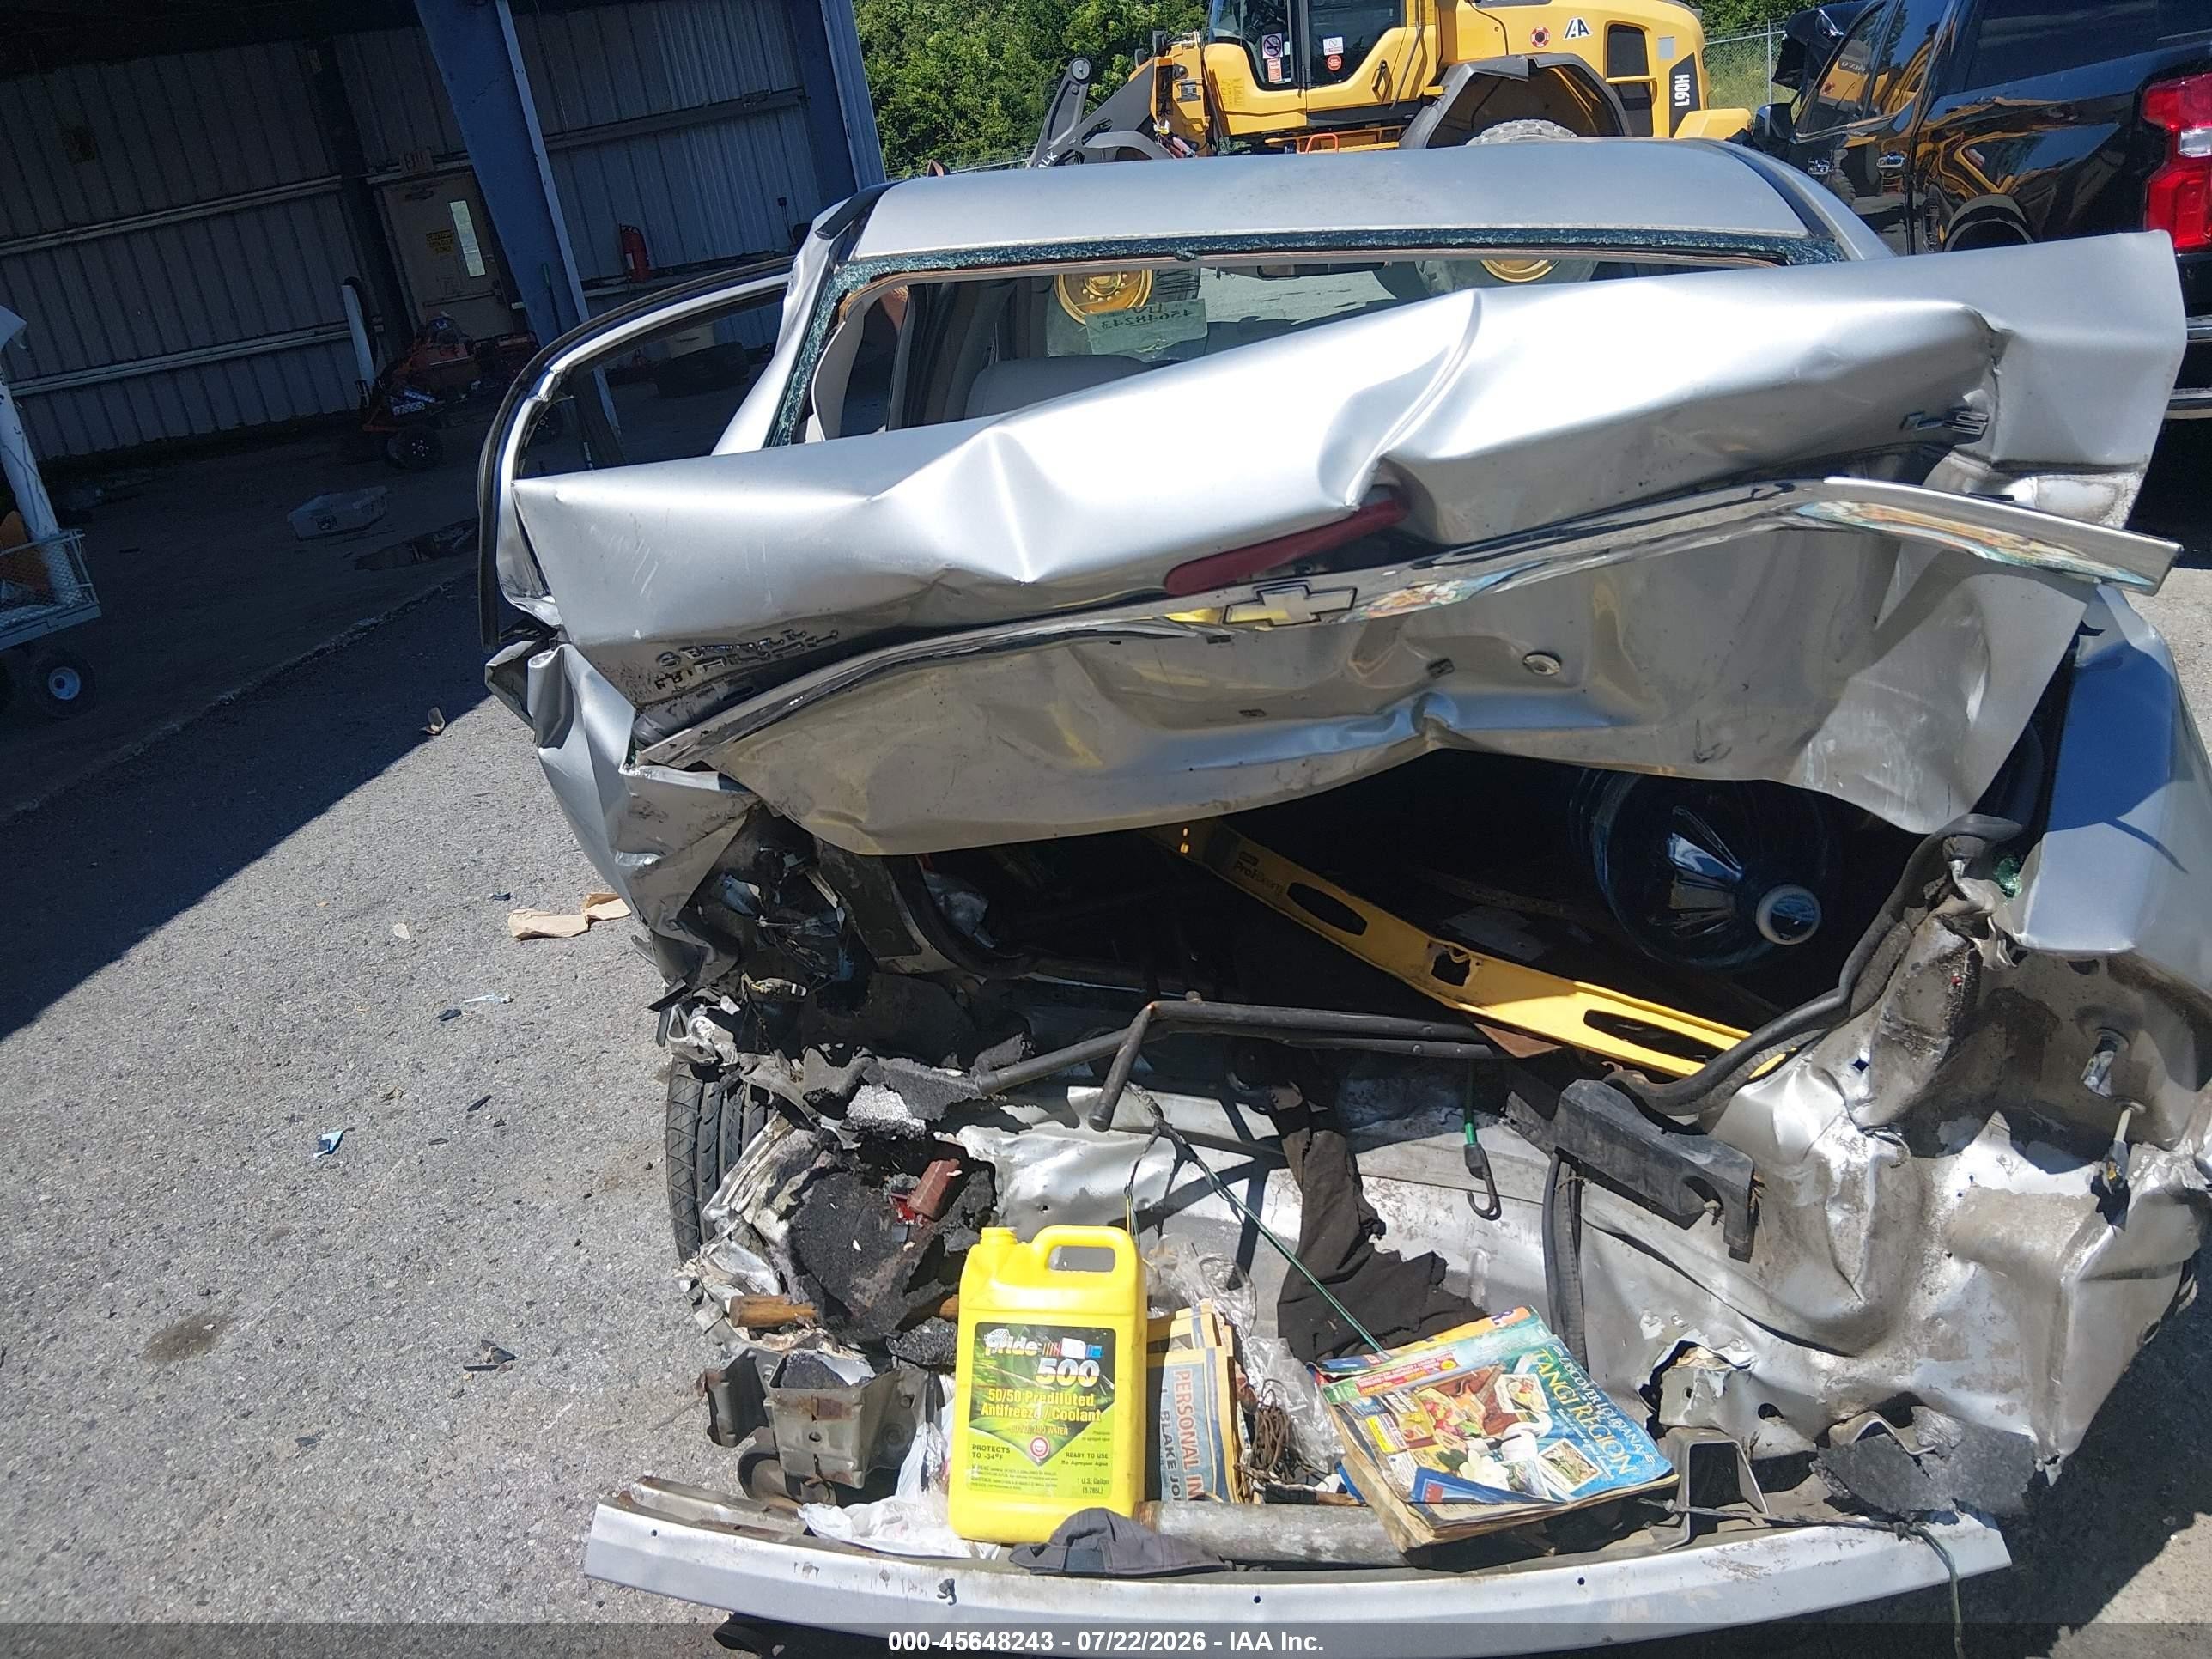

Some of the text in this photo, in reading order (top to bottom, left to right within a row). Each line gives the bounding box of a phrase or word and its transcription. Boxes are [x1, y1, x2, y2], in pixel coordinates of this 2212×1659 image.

[1674, 74, 1691, 107] L90H
[1036, 1358, 1100, 1388] 500
[981, 1401, 1042, 1419] Antifreeze
[1052, 1407, 1102, 1423] Coolant
[988, 1388, 1096, 1407] 50/50 Prediluted
[1536, 1348, 1580, 1406] TANGI
[1568, 1402, 1638, 1476] REGION
[1559, 1358, 1601, 1406] DISCOVER
[1595, 1402, 1644, 1453] LOUISIANA
[1047, 1425, 1069, 1437] WATER
[1175, 1370, 1199, 1471] PERSONAL
[972, 1444, 1011, 1454] PROTECTS
[1160, 1410, 1177, 1470] BLAKE
